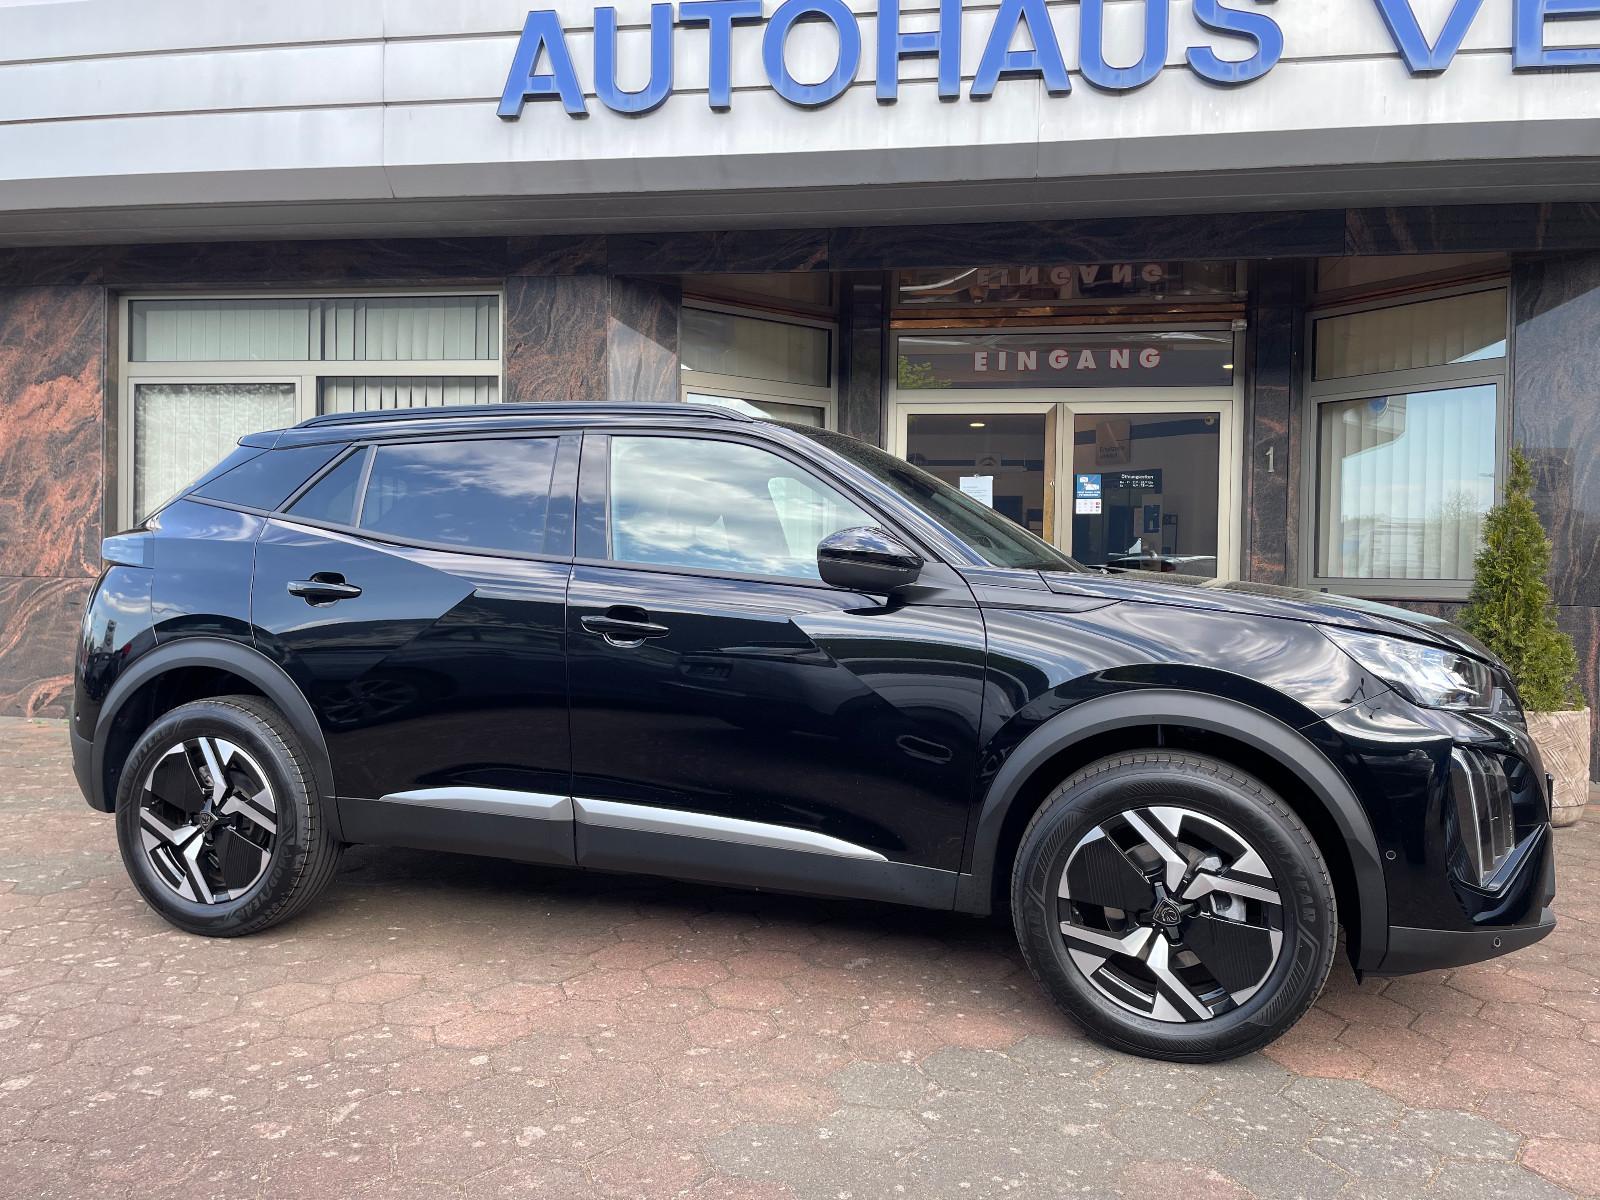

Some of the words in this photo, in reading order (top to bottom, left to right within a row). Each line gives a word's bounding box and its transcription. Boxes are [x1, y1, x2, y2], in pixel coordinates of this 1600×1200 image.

[496, 0, 1284, 121] AUTOHAUS
[973, 348, 1161, 371] EINGANG
[1261, 446, 1275, 473] 1
